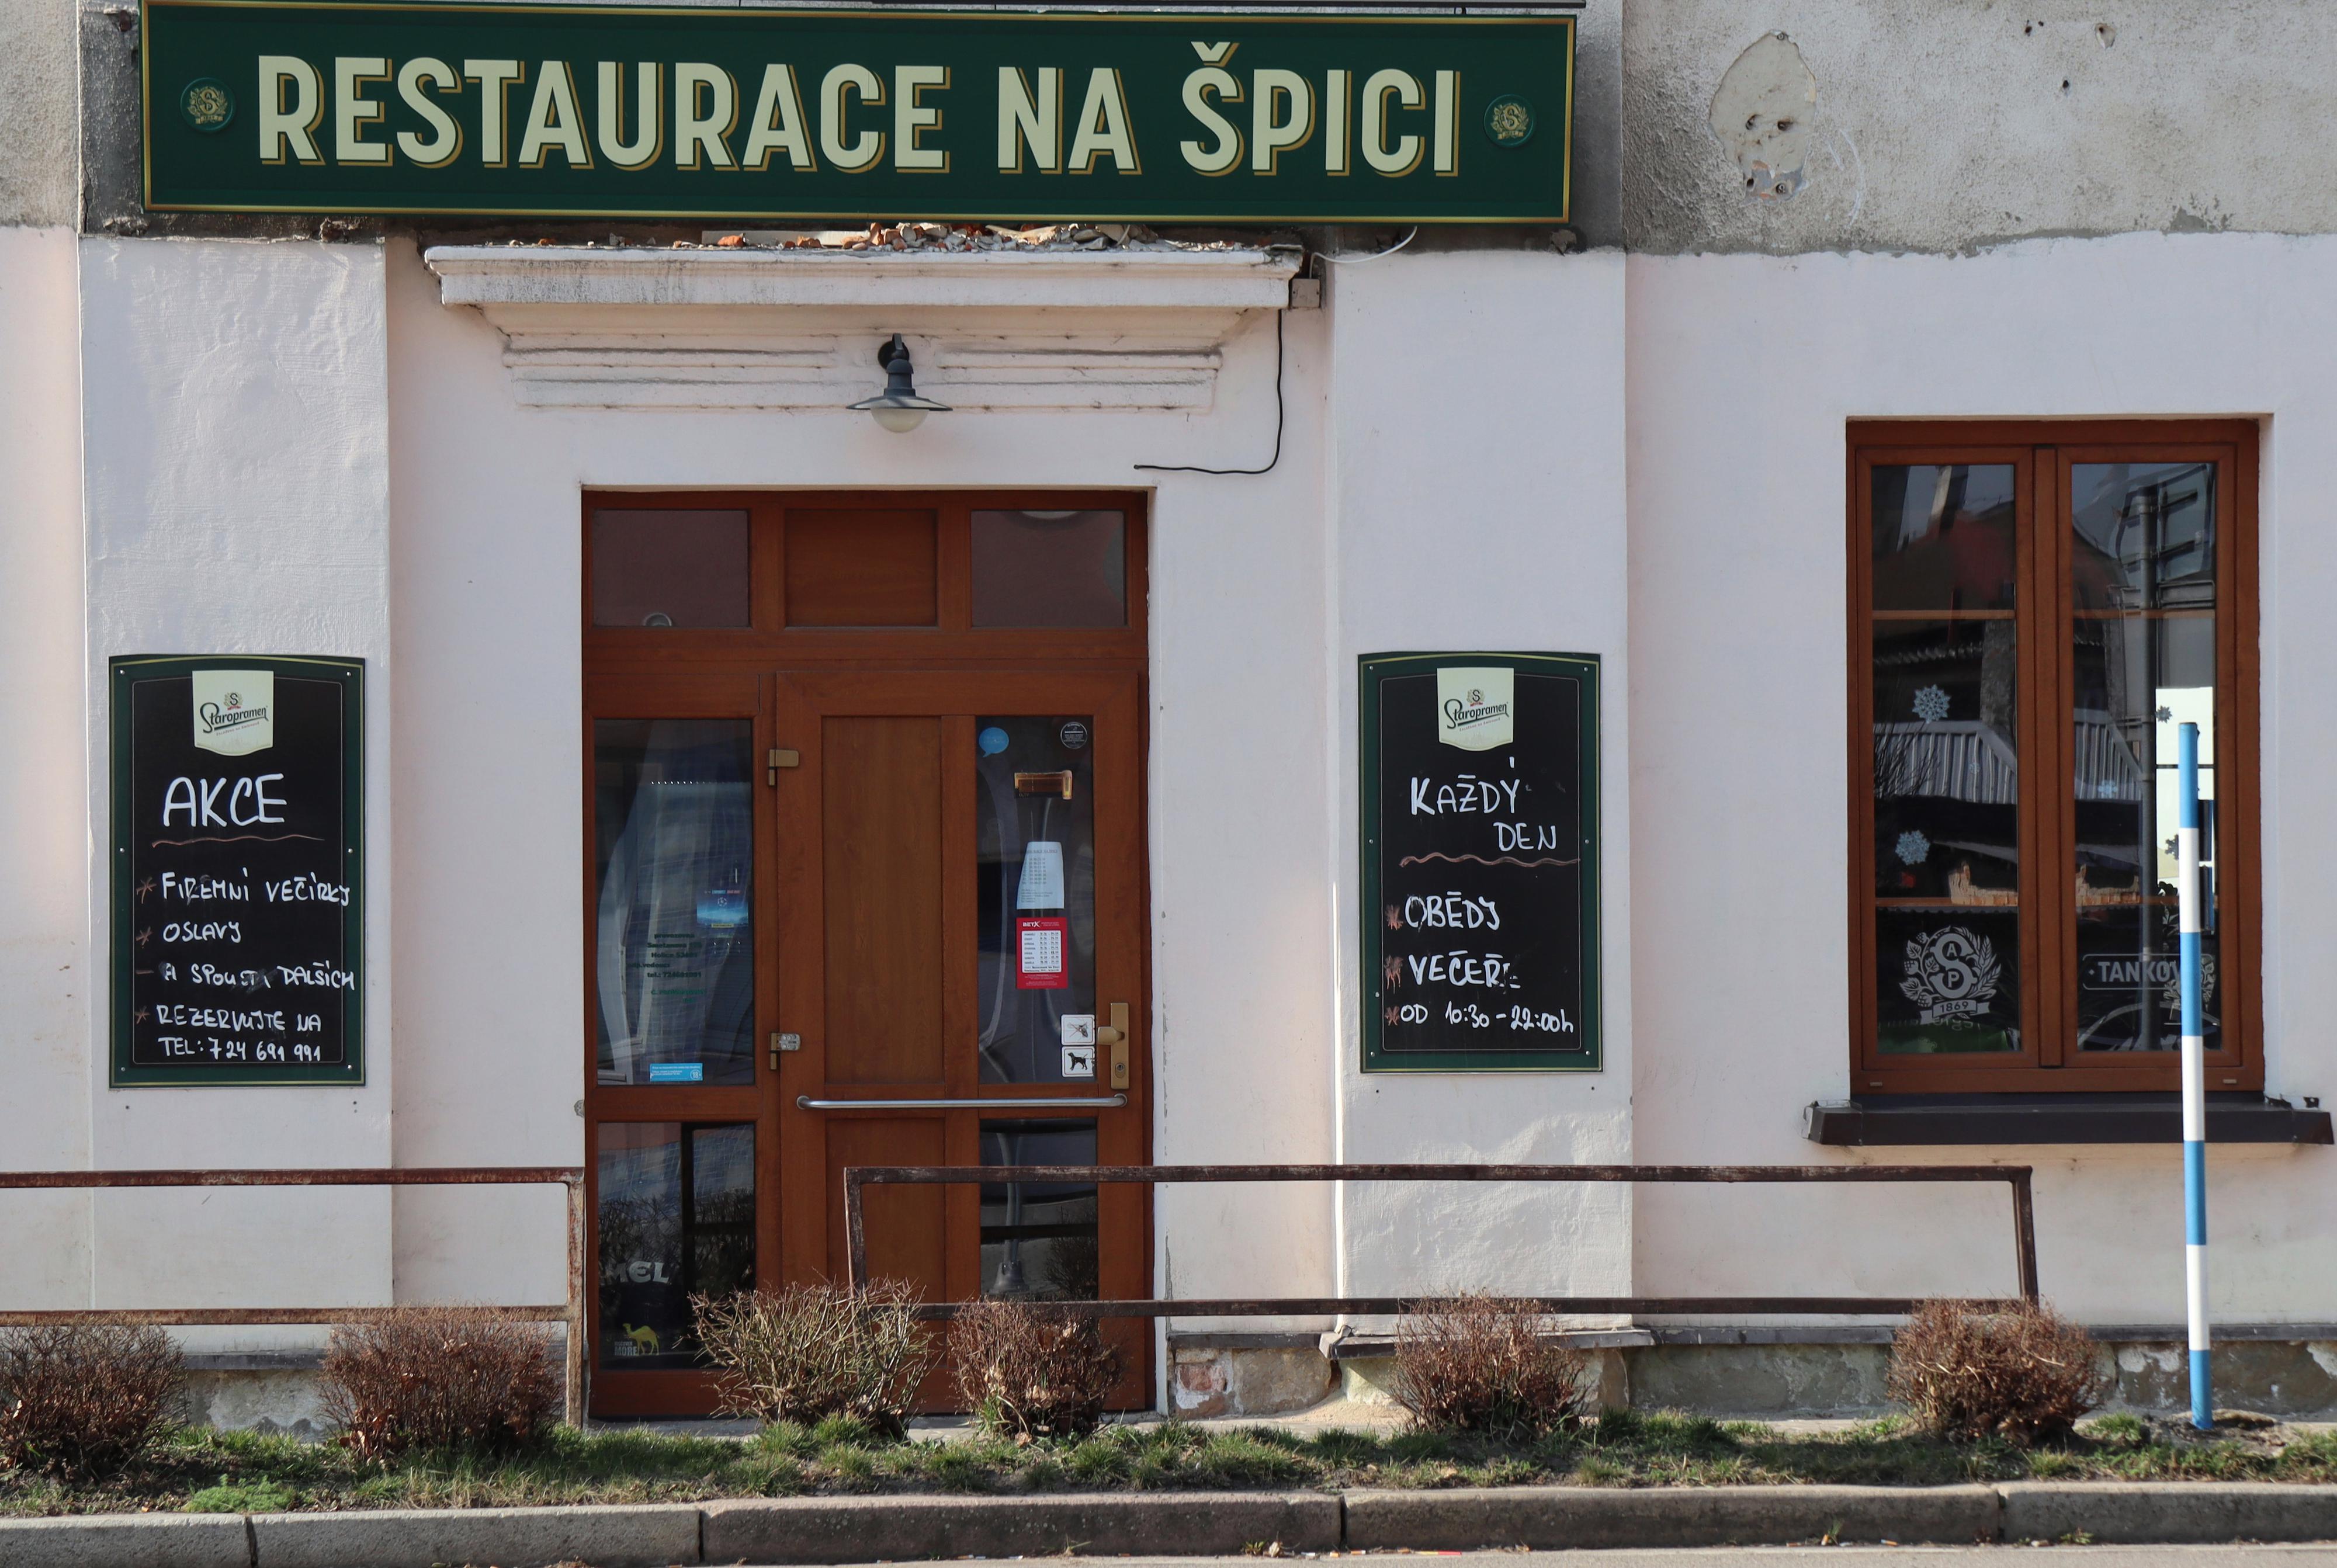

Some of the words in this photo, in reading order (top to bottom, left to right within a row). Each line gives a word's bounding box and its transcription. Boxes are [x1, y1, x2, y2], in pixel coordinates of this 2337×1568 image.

[259, 55, 950, 174] RESTAURACE
[998, 66, 1142, 175] NA
[1180, 41, 1461, 178] ŠPICI
[200, 702, 269, 734] Staropramen
[1444, 699, 1509, 729] Staropramen
[163, 773, 287, 827] AKCE
[1410, 756, 1520, 816] KAŽDÝ
[1493, 821, 1556, 852] DEN
[163, 921, 241, 943] OSLAVY
[2097, 961, 2181, 983] TANKOV
[156, 1004, 286, 1032] REZERVUJTE
[297, 1014, 321, 1032] NA
[1400, 1003, 1428, 1024] OD
[1940, 1001, 1969, 1013] 1869
[256, 1041, 285, 1061] 691
[615, 1346, 638, 1356] MORE
